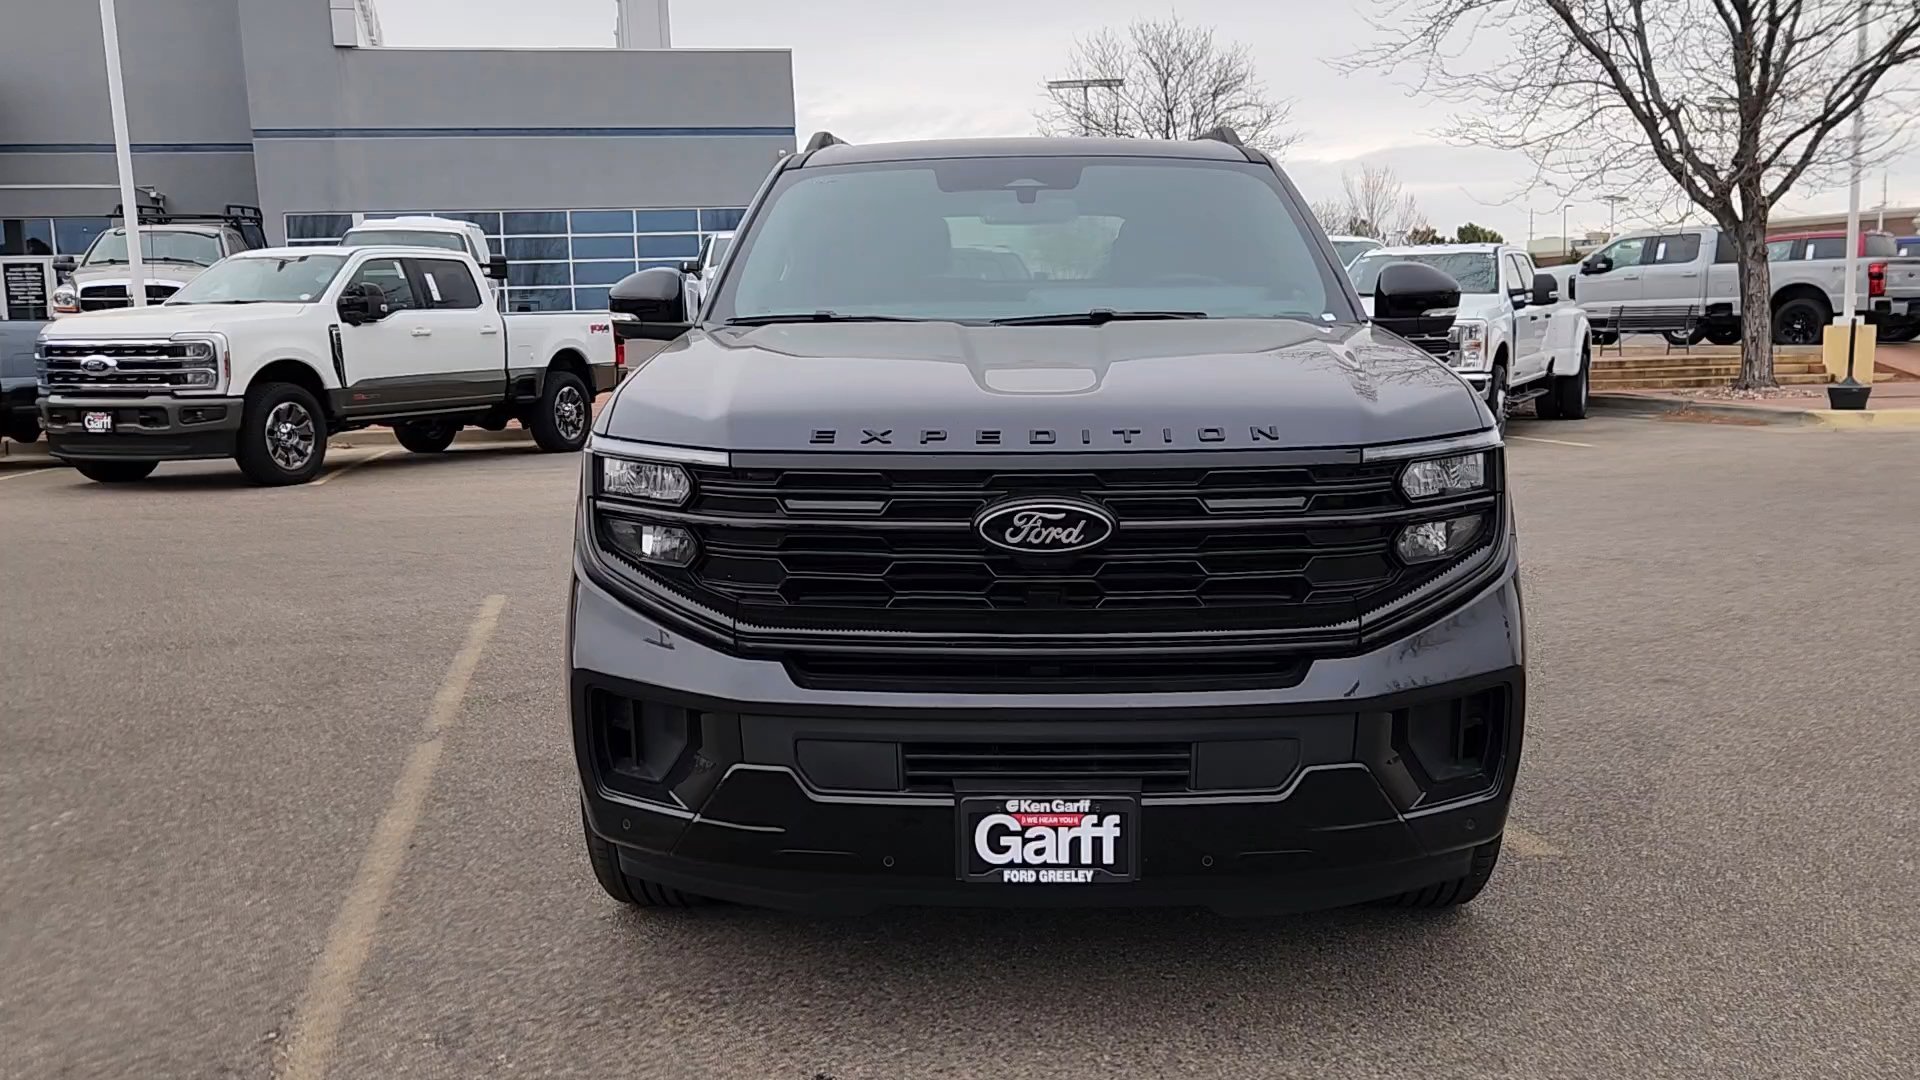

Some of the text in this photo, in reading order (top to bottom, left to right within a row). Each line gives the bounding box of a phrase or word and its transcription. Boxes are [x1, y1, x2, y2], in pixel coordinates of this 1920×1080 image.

[809, 425, 1279, 445] EXPEDITION
[1004, 510, 1084, 545] Ford
[1020, 800, 1091, 813] Ken Garff
[1027, 816, 1073, 824] WE HEAR YOU
[974, 813, 1121, 865] Garff
[1003, 870, 1093, 882] FORD GREELEY
